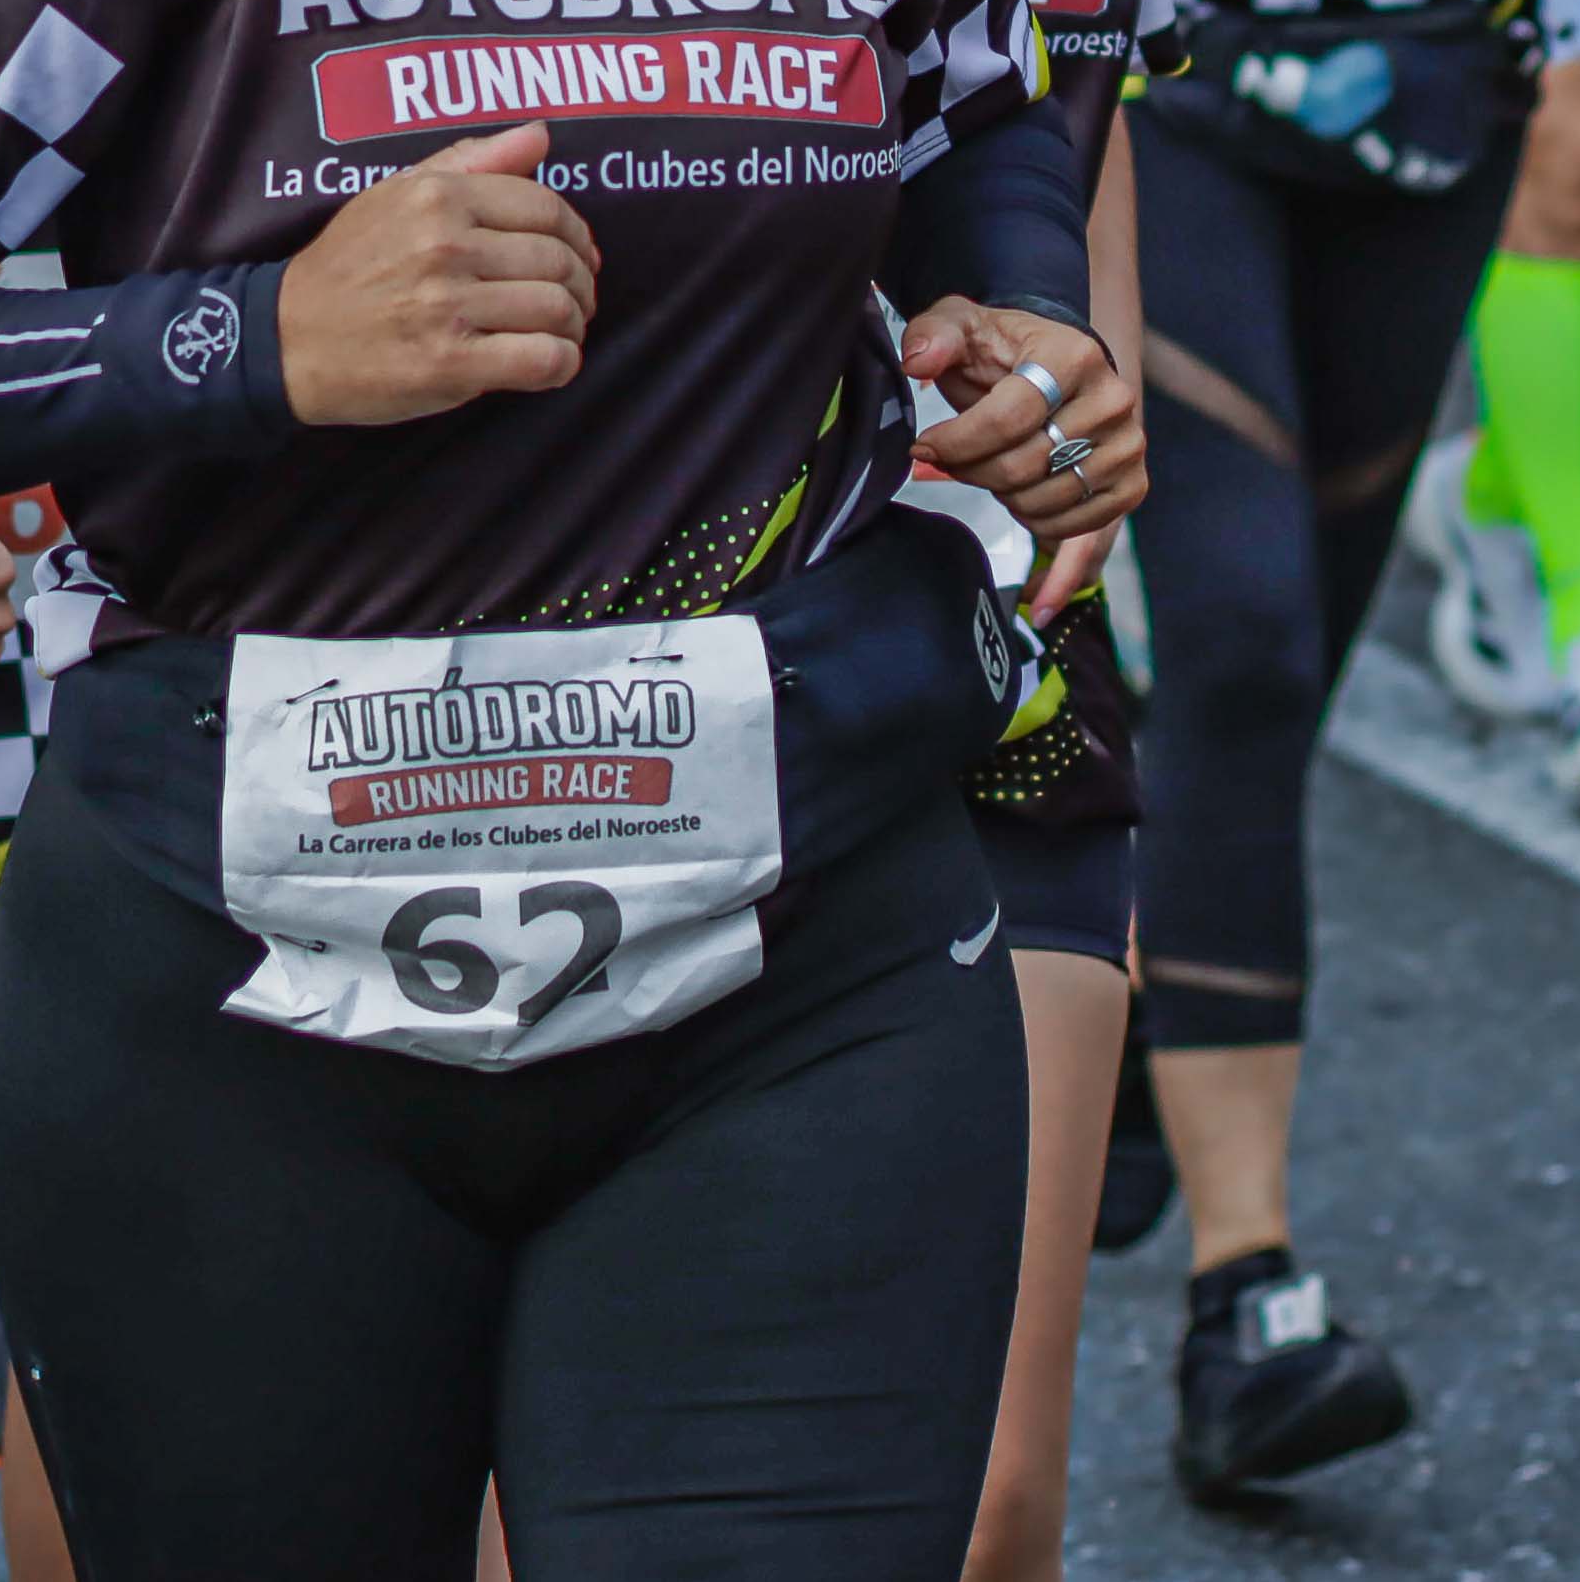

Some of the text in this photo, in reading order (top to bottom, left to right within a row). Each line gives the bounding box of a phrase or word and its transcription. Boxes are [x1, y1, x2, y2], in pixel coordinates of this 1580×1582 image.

[386, 40, 839, 124] RUNNING RACE
[265, 160, 303, 198] La
[314, 157, 418, 195] Carr
[537, 156, 589, 191] los
[601, 150, 724, 191] Clubes
[737, 146, 792, 186] del
[309, 667, 696, 771] AUTÓDROMO
[368, 762, 632, 817] RUNNING RACE
[298, 815, 701, 855] La Carrera de los Clubes del Noroeste
[381, 880, 622, 1027] 62
